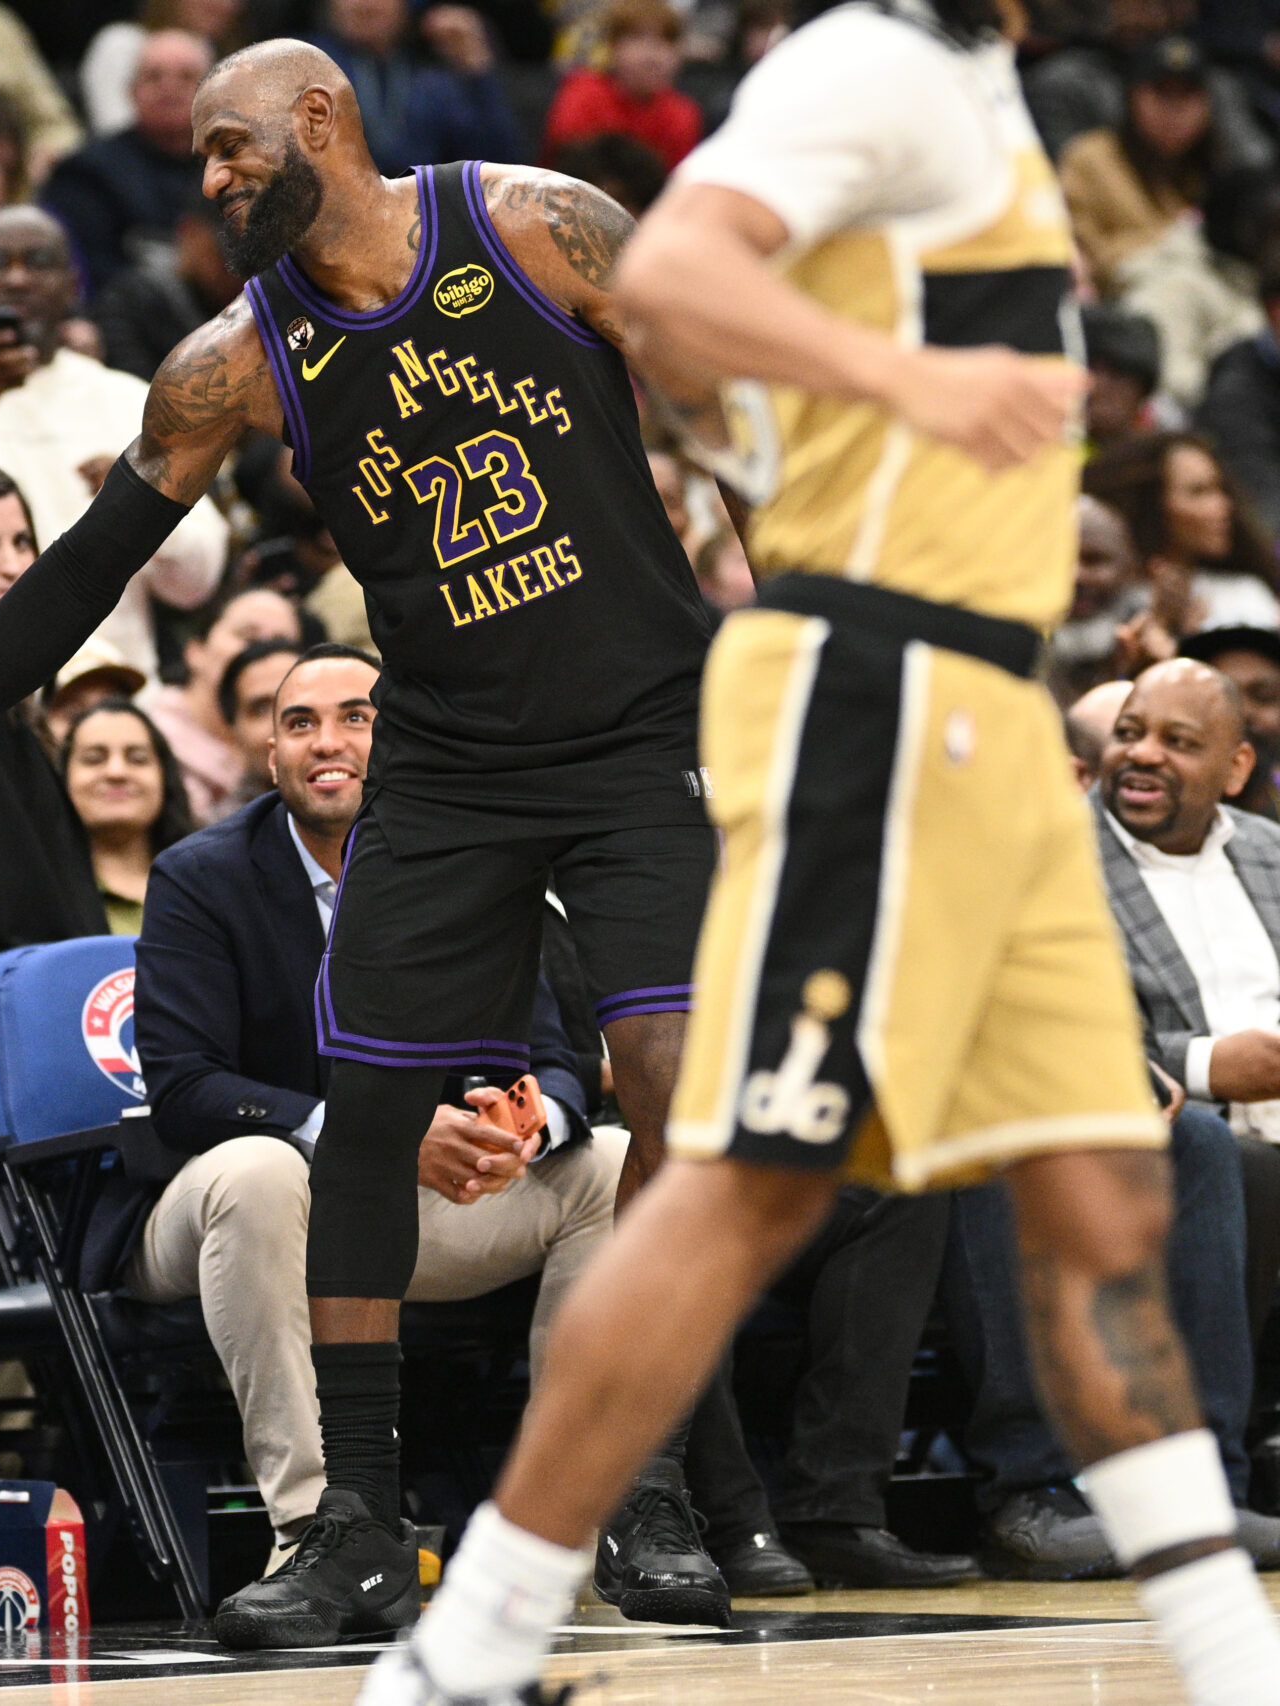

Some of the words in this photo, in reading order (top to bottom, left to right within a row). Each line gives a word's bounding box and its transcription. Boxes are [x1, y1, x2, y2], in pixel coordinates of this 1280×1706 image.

[437, 275, 489, 305] bibigo
[351, 427, 402, 526] LOS
[387, 338, 573, 436] ANGELES
[401, 428, 549, 570] 23
[438, 534, 584, 628] LAKERS
[60, 1531, 79, 1632] POPCO
